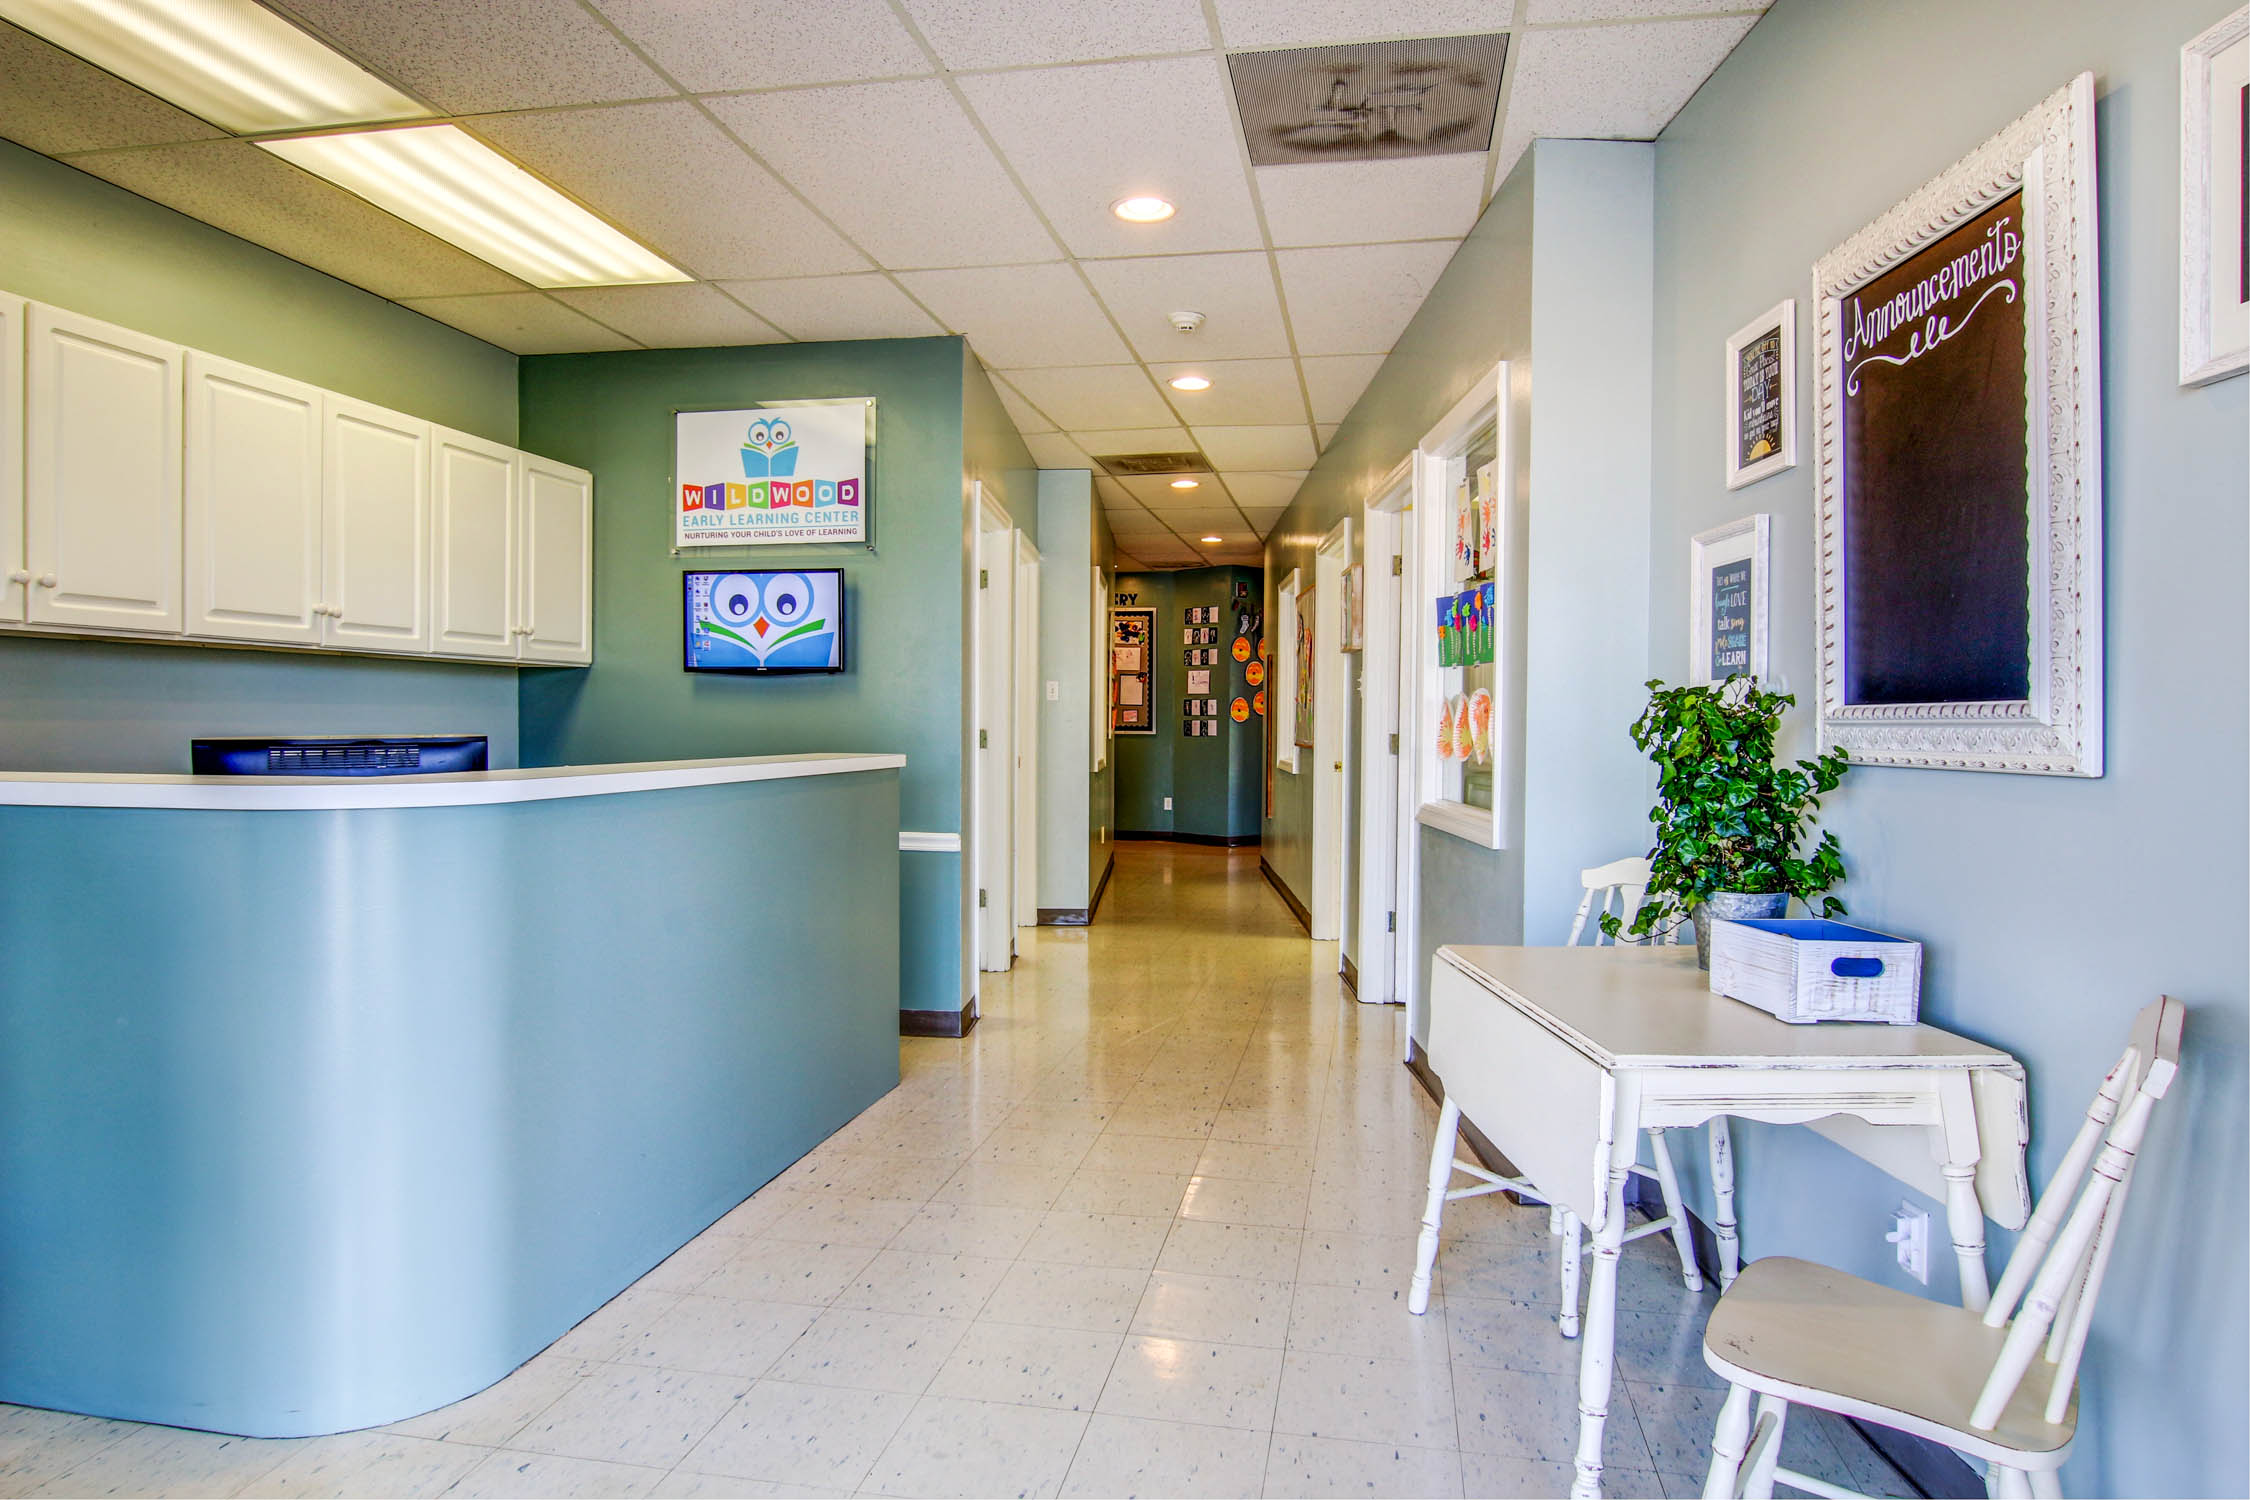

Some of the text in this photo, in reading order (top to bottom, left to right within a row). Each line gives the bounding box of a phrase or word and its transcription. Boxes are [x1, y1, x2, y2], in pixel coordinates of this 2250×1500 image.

[1844, 216, 2021, 361] Announcements
[1751, 378, 1770, 403] DAY
[684, 484, 855, 506] WILDWOOD
[683, 510, 859, 527] EARLY LEARNING CENTER
[684, 527, 858, 540] NURTURING YOUR CHILD'S LOVE OF LEARNING
[1730, 590, 1747, 608] LOVE
[1718, 615, 1730, 631] talk
[1722, 650, 1746, 666] LEARN
